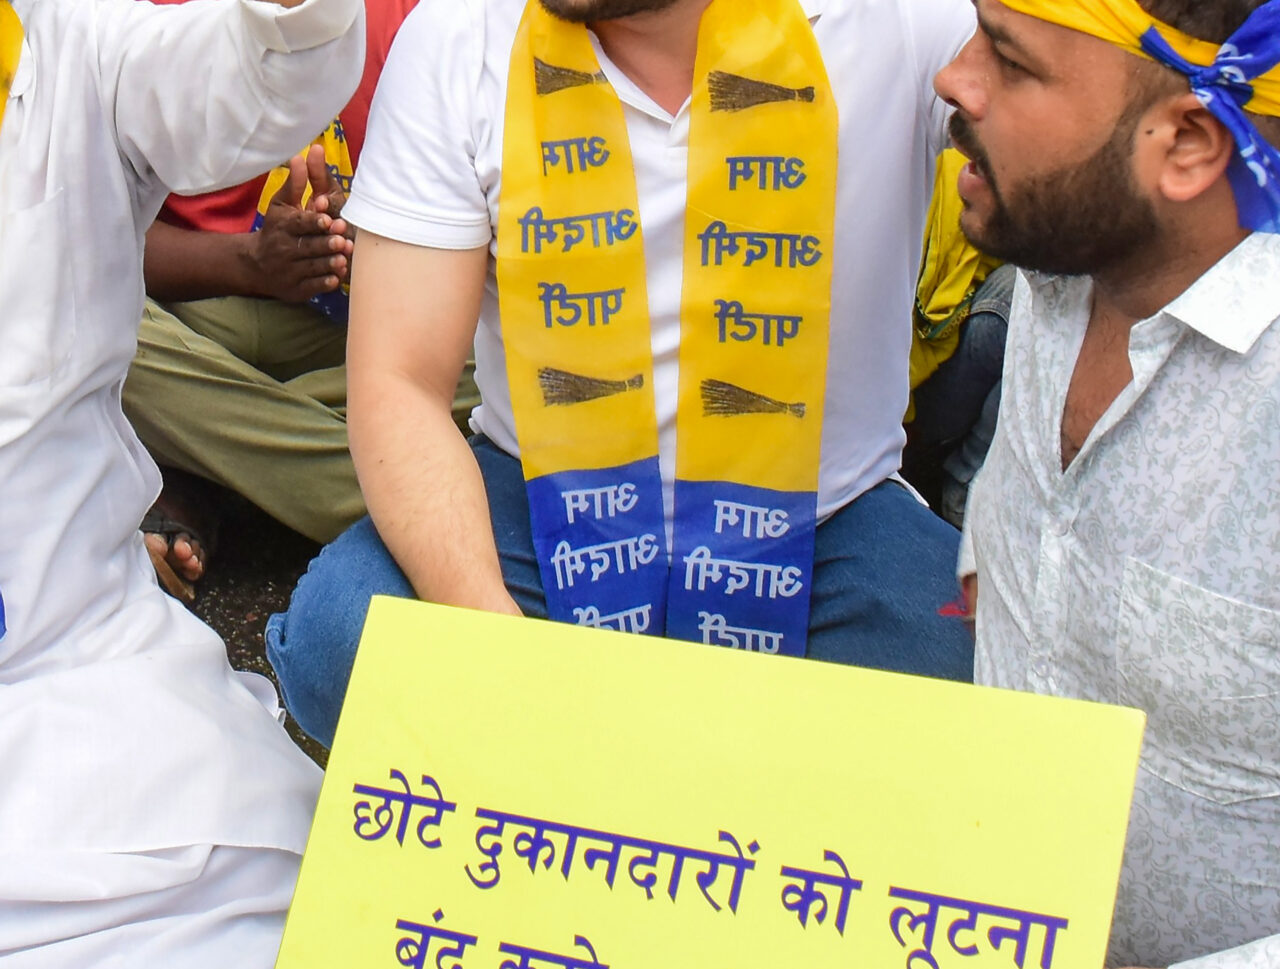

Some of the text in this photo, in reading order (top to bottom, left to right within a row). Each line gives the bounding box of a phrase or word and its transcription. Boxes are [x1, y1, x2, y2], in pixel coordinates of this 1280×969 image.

[352, 768, 1069, 969] छोटे दुकानदारों को लूटना
